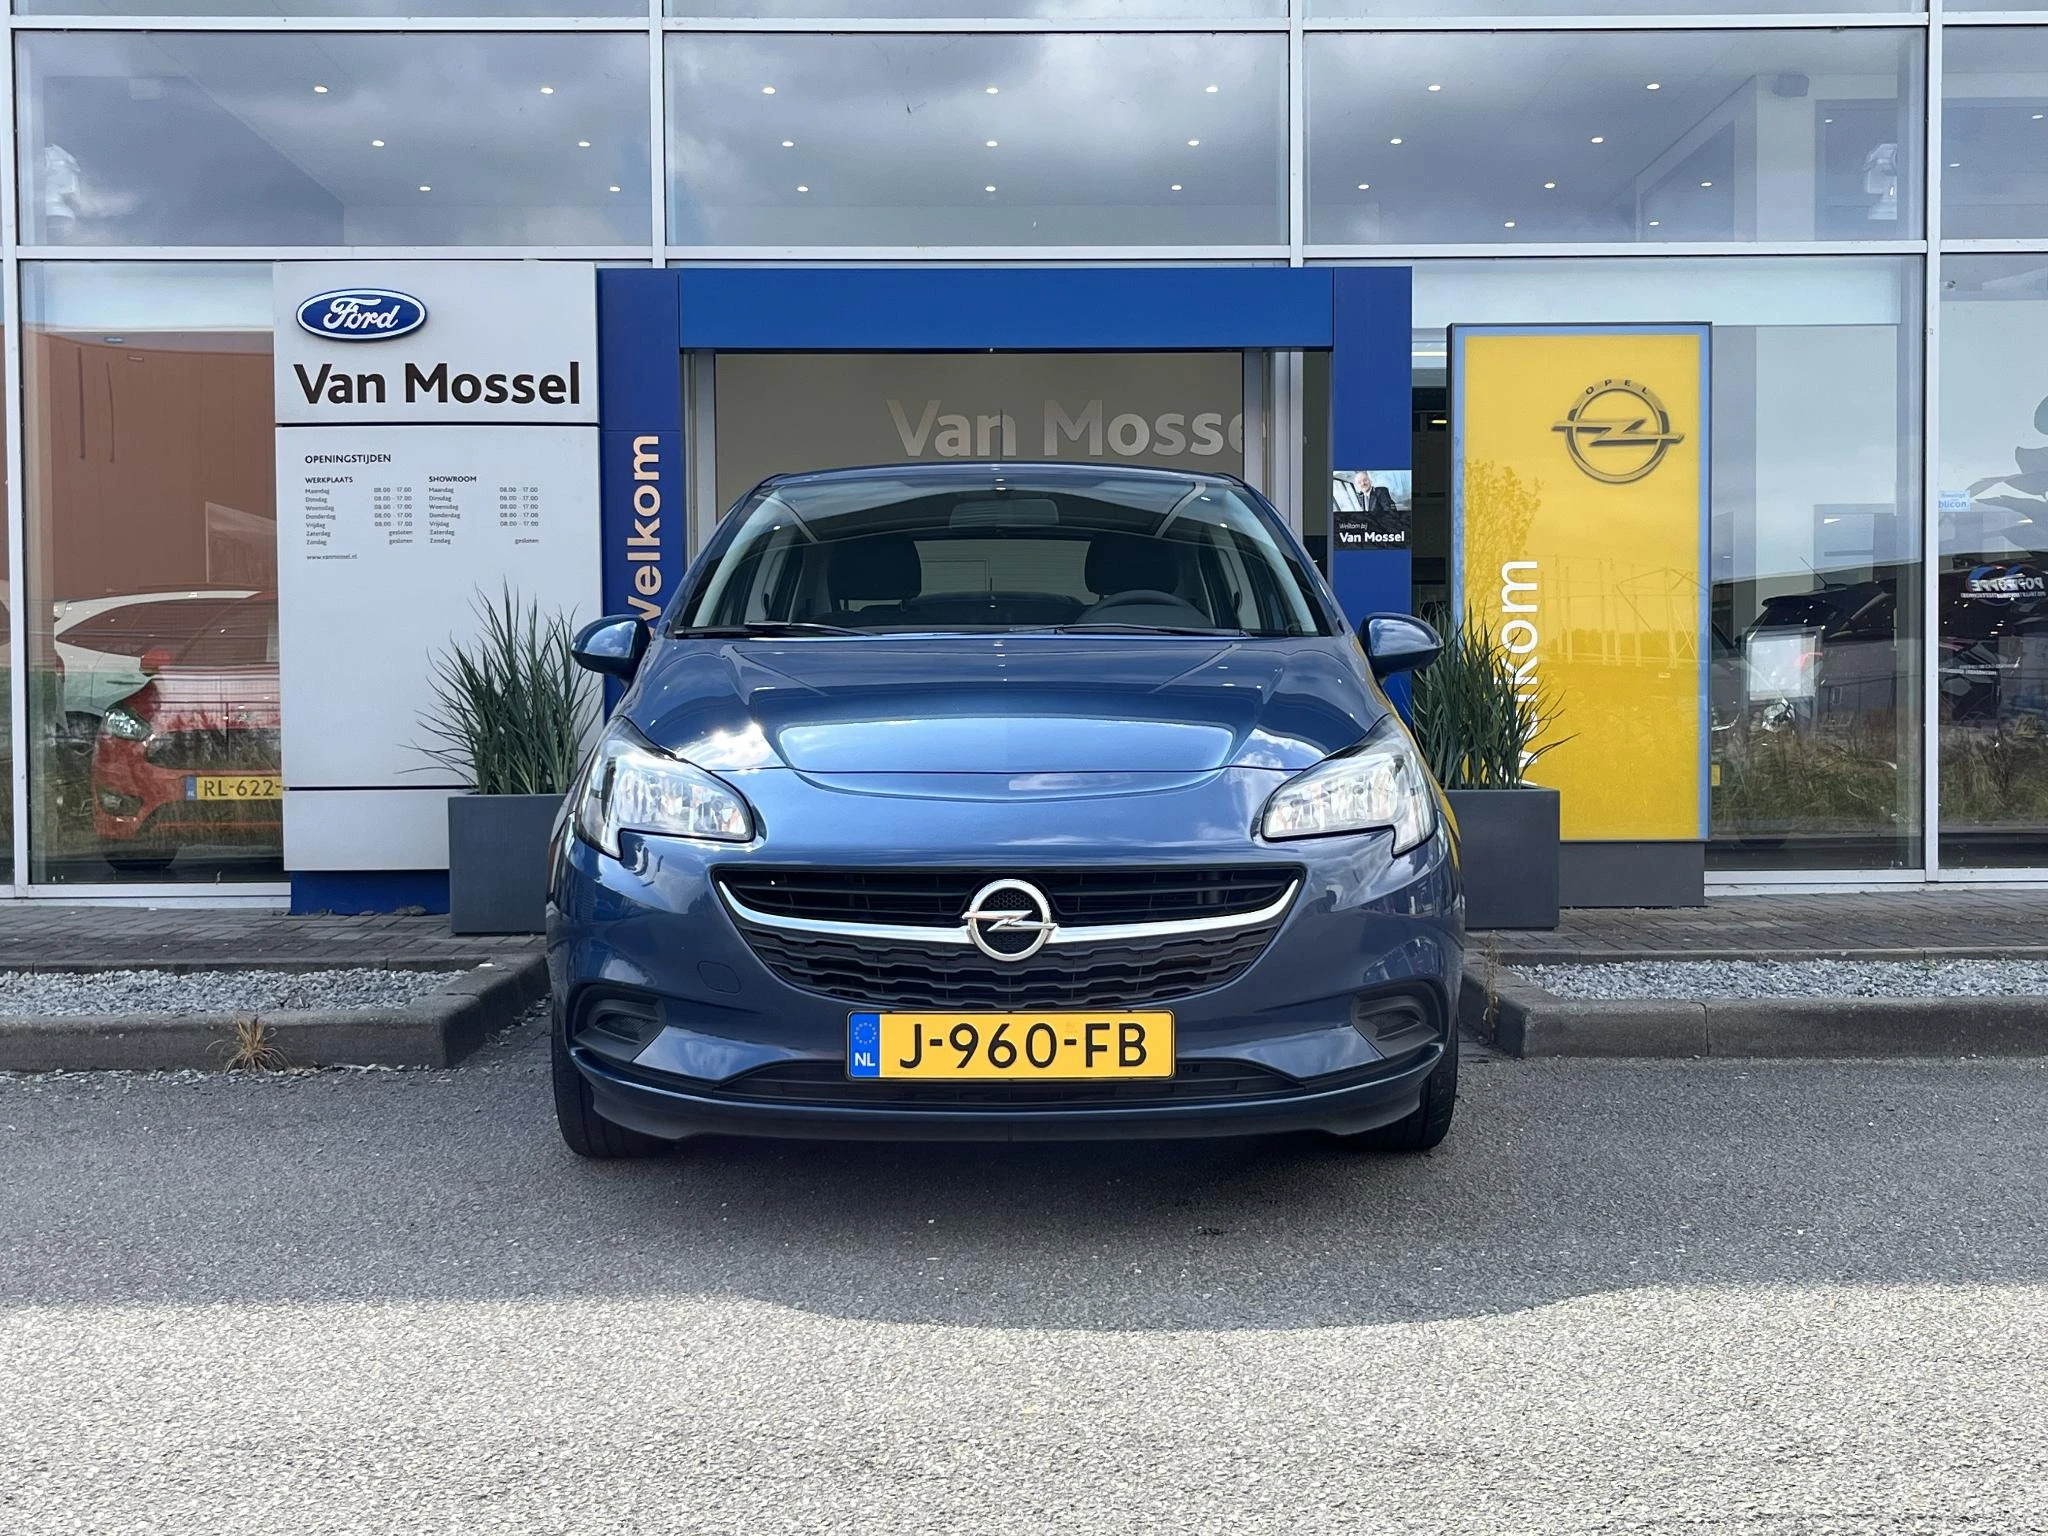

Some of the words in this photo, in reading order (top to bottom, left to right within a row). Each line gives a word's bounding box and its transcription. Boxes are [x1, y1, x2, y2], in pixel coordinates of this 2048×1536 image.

[323, 298, 400, 329] Ford
[294, 363, 386, 404] Van
[405, 361, 580, 404] Mossel
[1585, 379, 1648, 395] OPEL
[886, 399, 1017, 456] Van
[304, 454, 391, 464] OPENINGSTIJDEN
[304, 476, 353, 484] WERKPLAATS
[1339, 532, 1361, 543] Van
[1364, 531, 1405, 542] Mossel
[854, 1052, 876, 1067] NL
[899, 1022, 1148, 1069] J-960-FB
